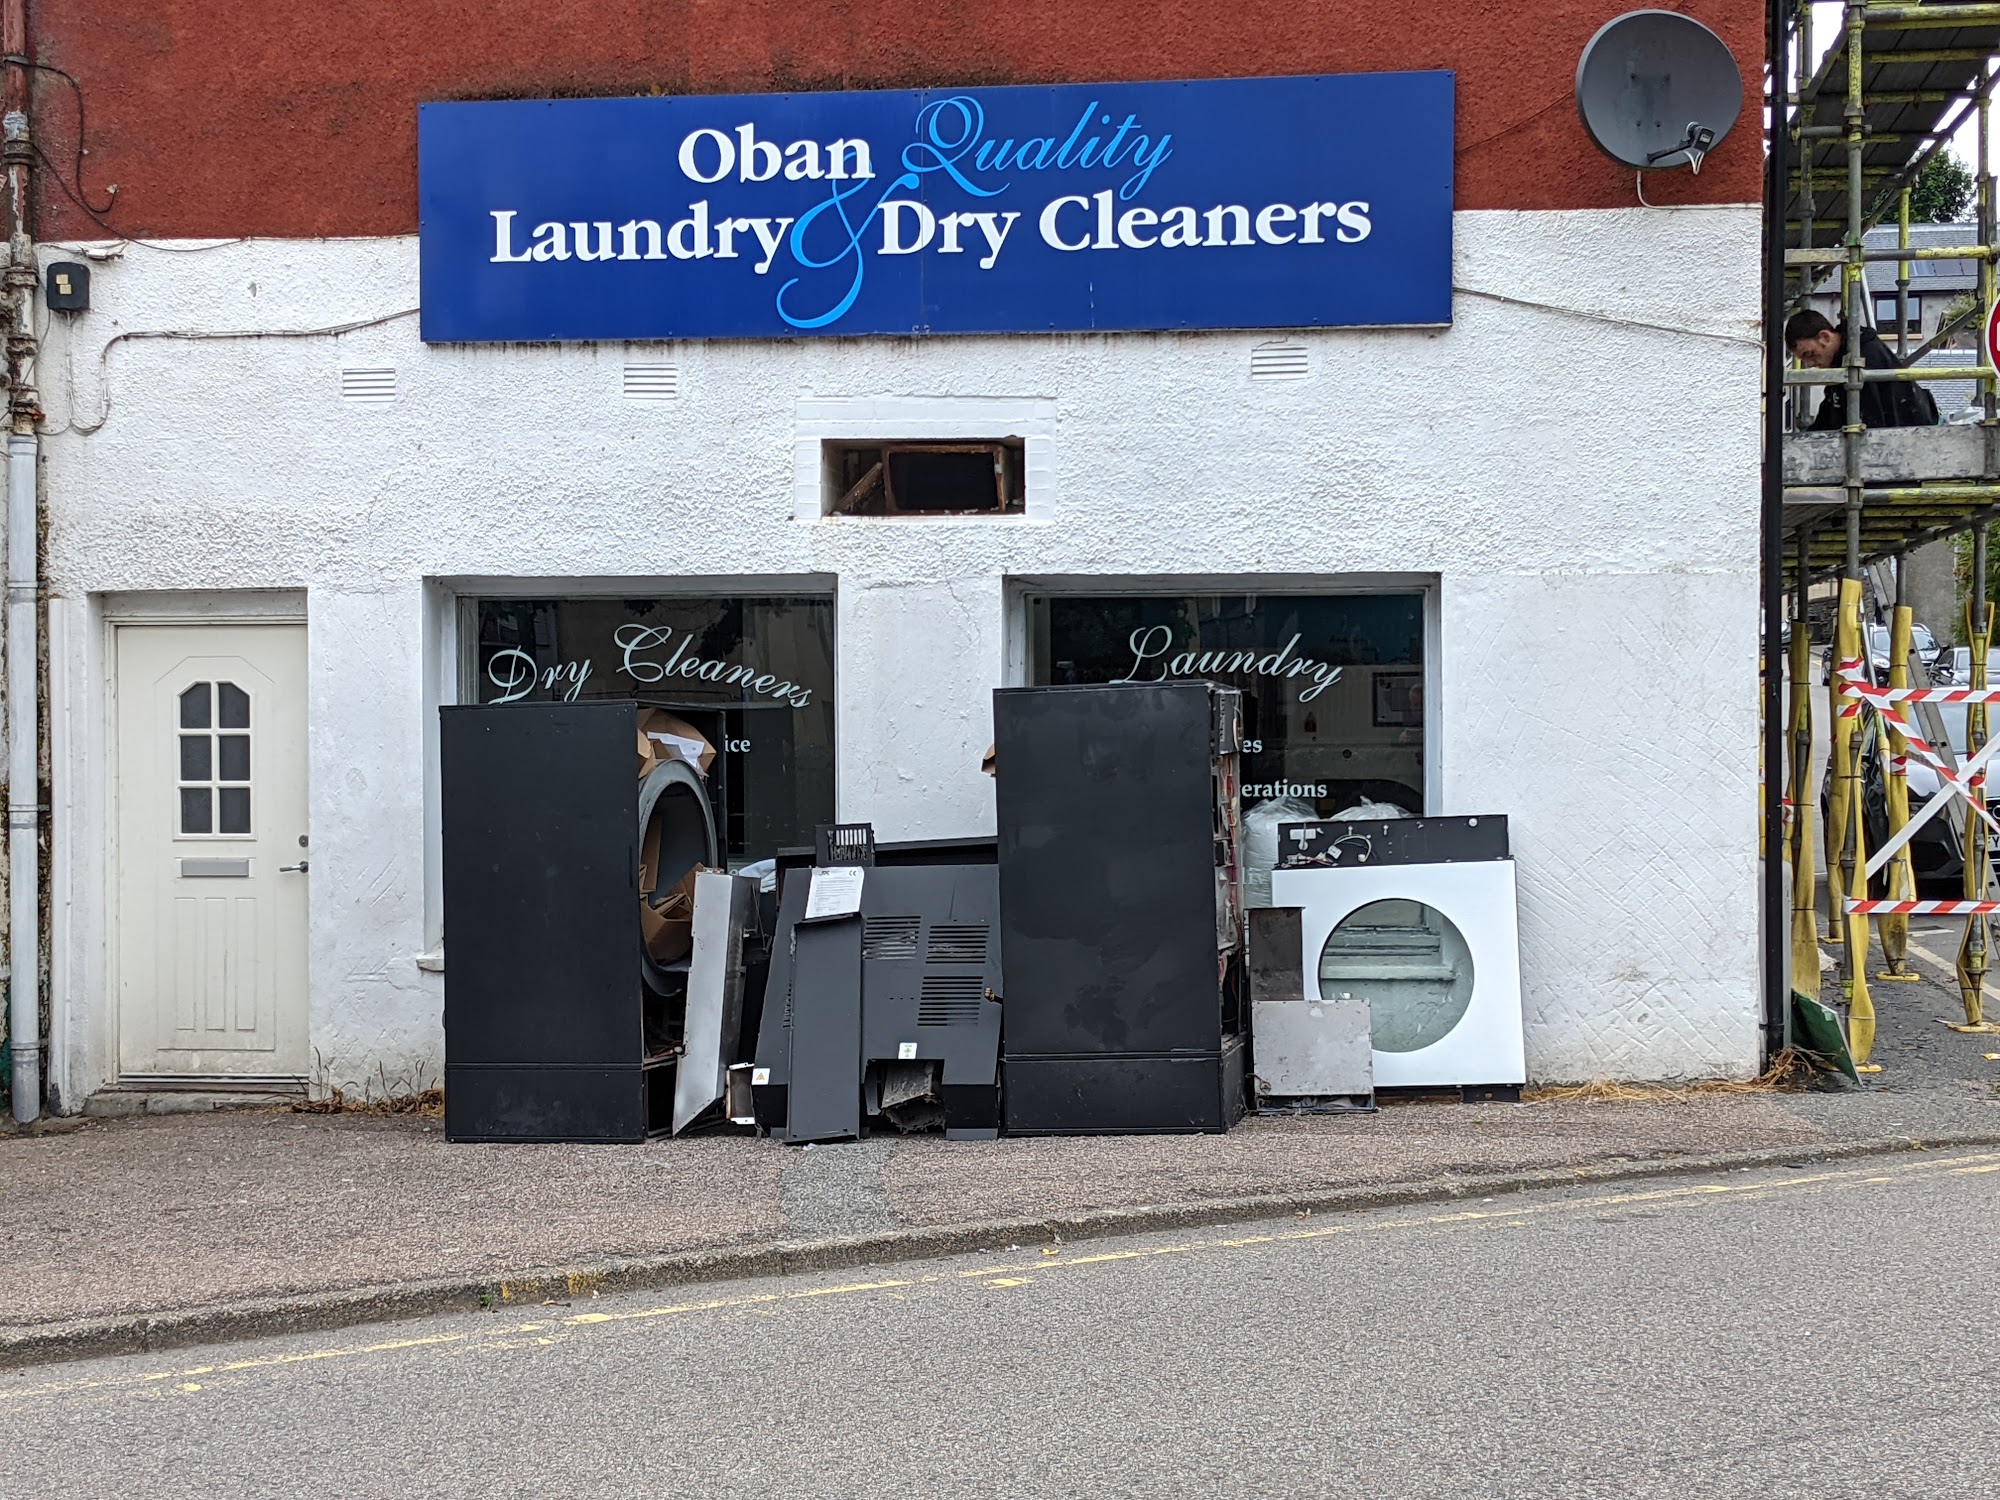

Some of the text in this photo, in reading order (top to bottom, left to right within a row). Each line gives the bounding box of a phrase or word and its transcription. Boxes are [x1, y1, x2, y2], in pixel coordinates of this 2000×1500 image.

[677, 94, 1173, 199] Oban Quality
[489, 151, 1372, 328] Laundry & Dry Cleaners
[487, 623, 813, 709] Dry Cleaners
[1109, 624, 1343, 704] Laundry
[1239, 778, 1328, 799] erations
